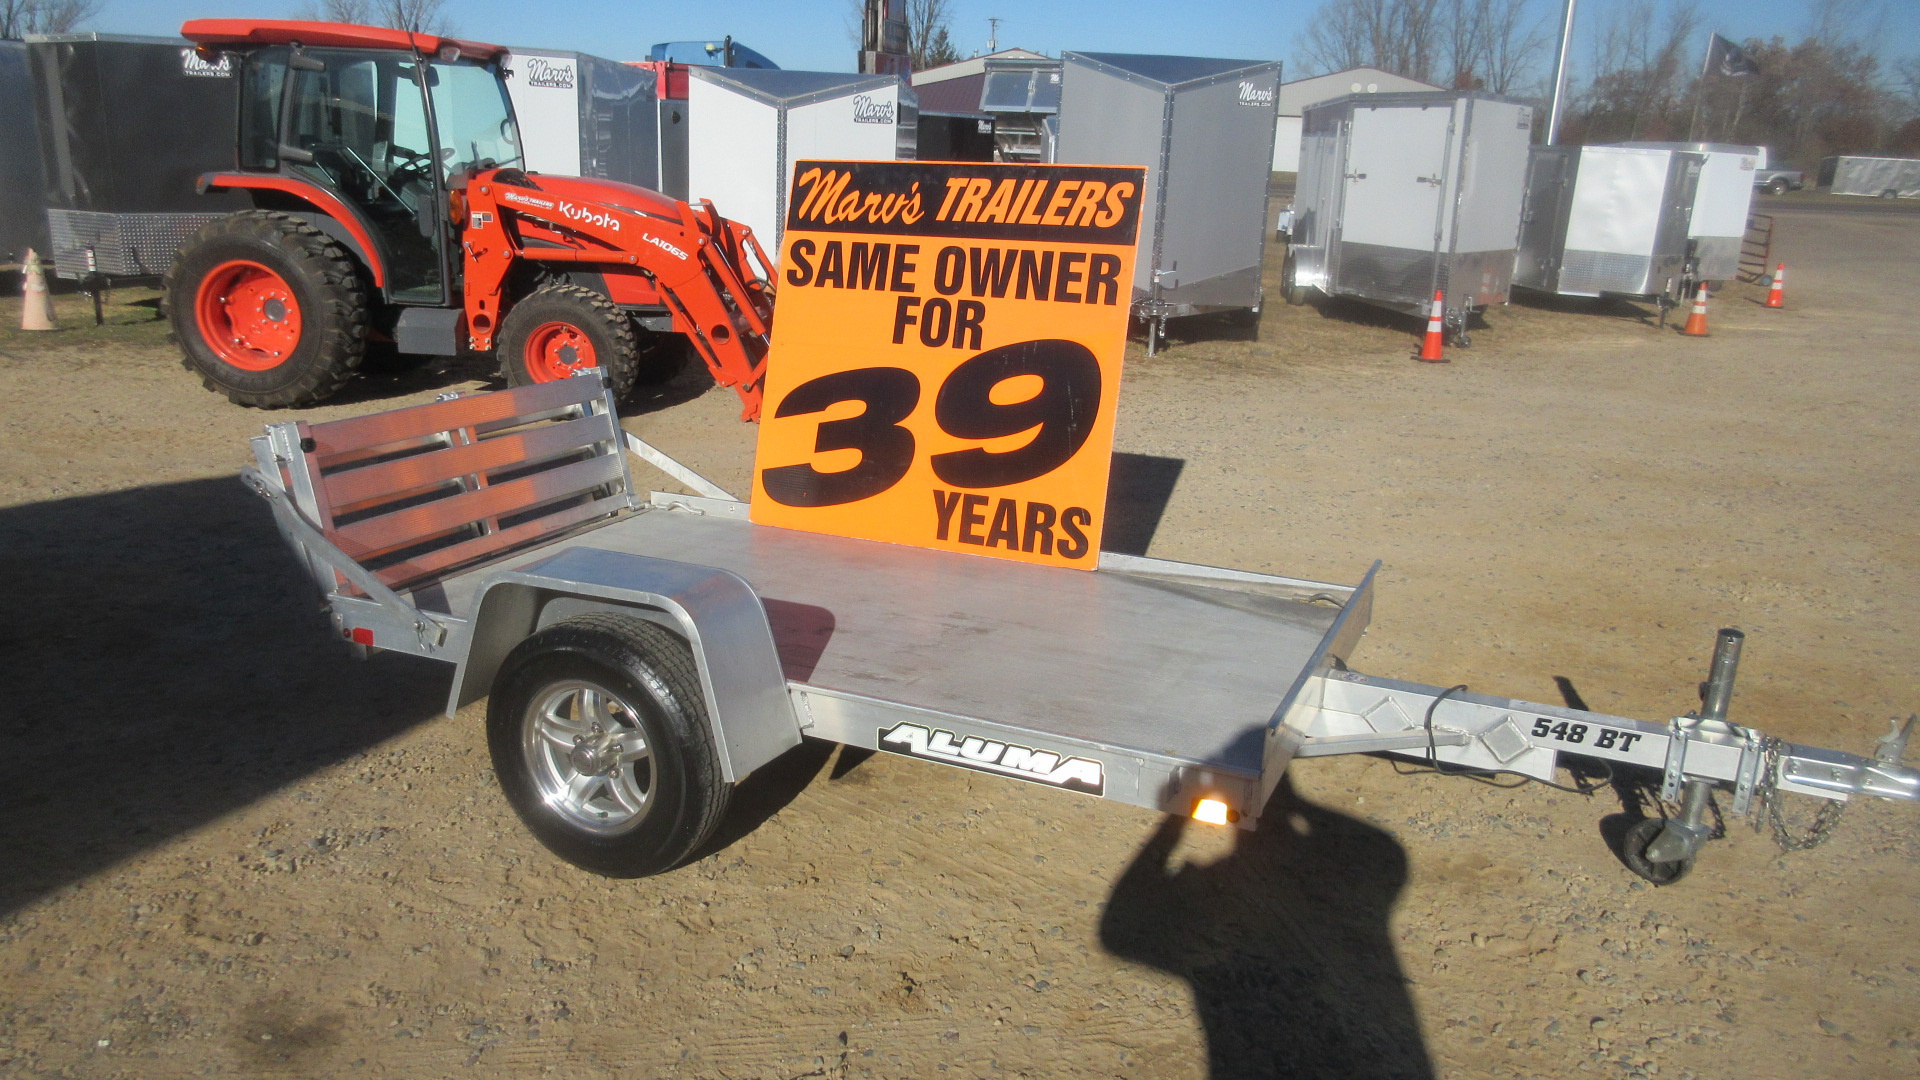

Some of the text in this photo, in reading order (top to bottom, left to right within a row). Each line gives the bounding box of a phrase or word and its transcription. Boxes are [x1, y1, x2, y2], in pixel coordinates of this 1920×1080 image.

[528, 58, 574, 82] Marv's
[1239, 81, 1273, 101] Marv's
[853, 95, 894, 118] Marv's
[559, 201, 620, 231] Kubota
[798, 167, 1135, 228] Marv's TRAILERS
[642, 233, 689, 261] LA1065
[787, 239, 1122, 306] SAME OWNER
[892, 296, 986, 350] FOR
[762, 338, 1102, 507] 39
[932, 489, 1092, 559] YEARS
[883, 723, 1102, 786] ALUMA
[1531, 717, 1642, 752] 548 BT
